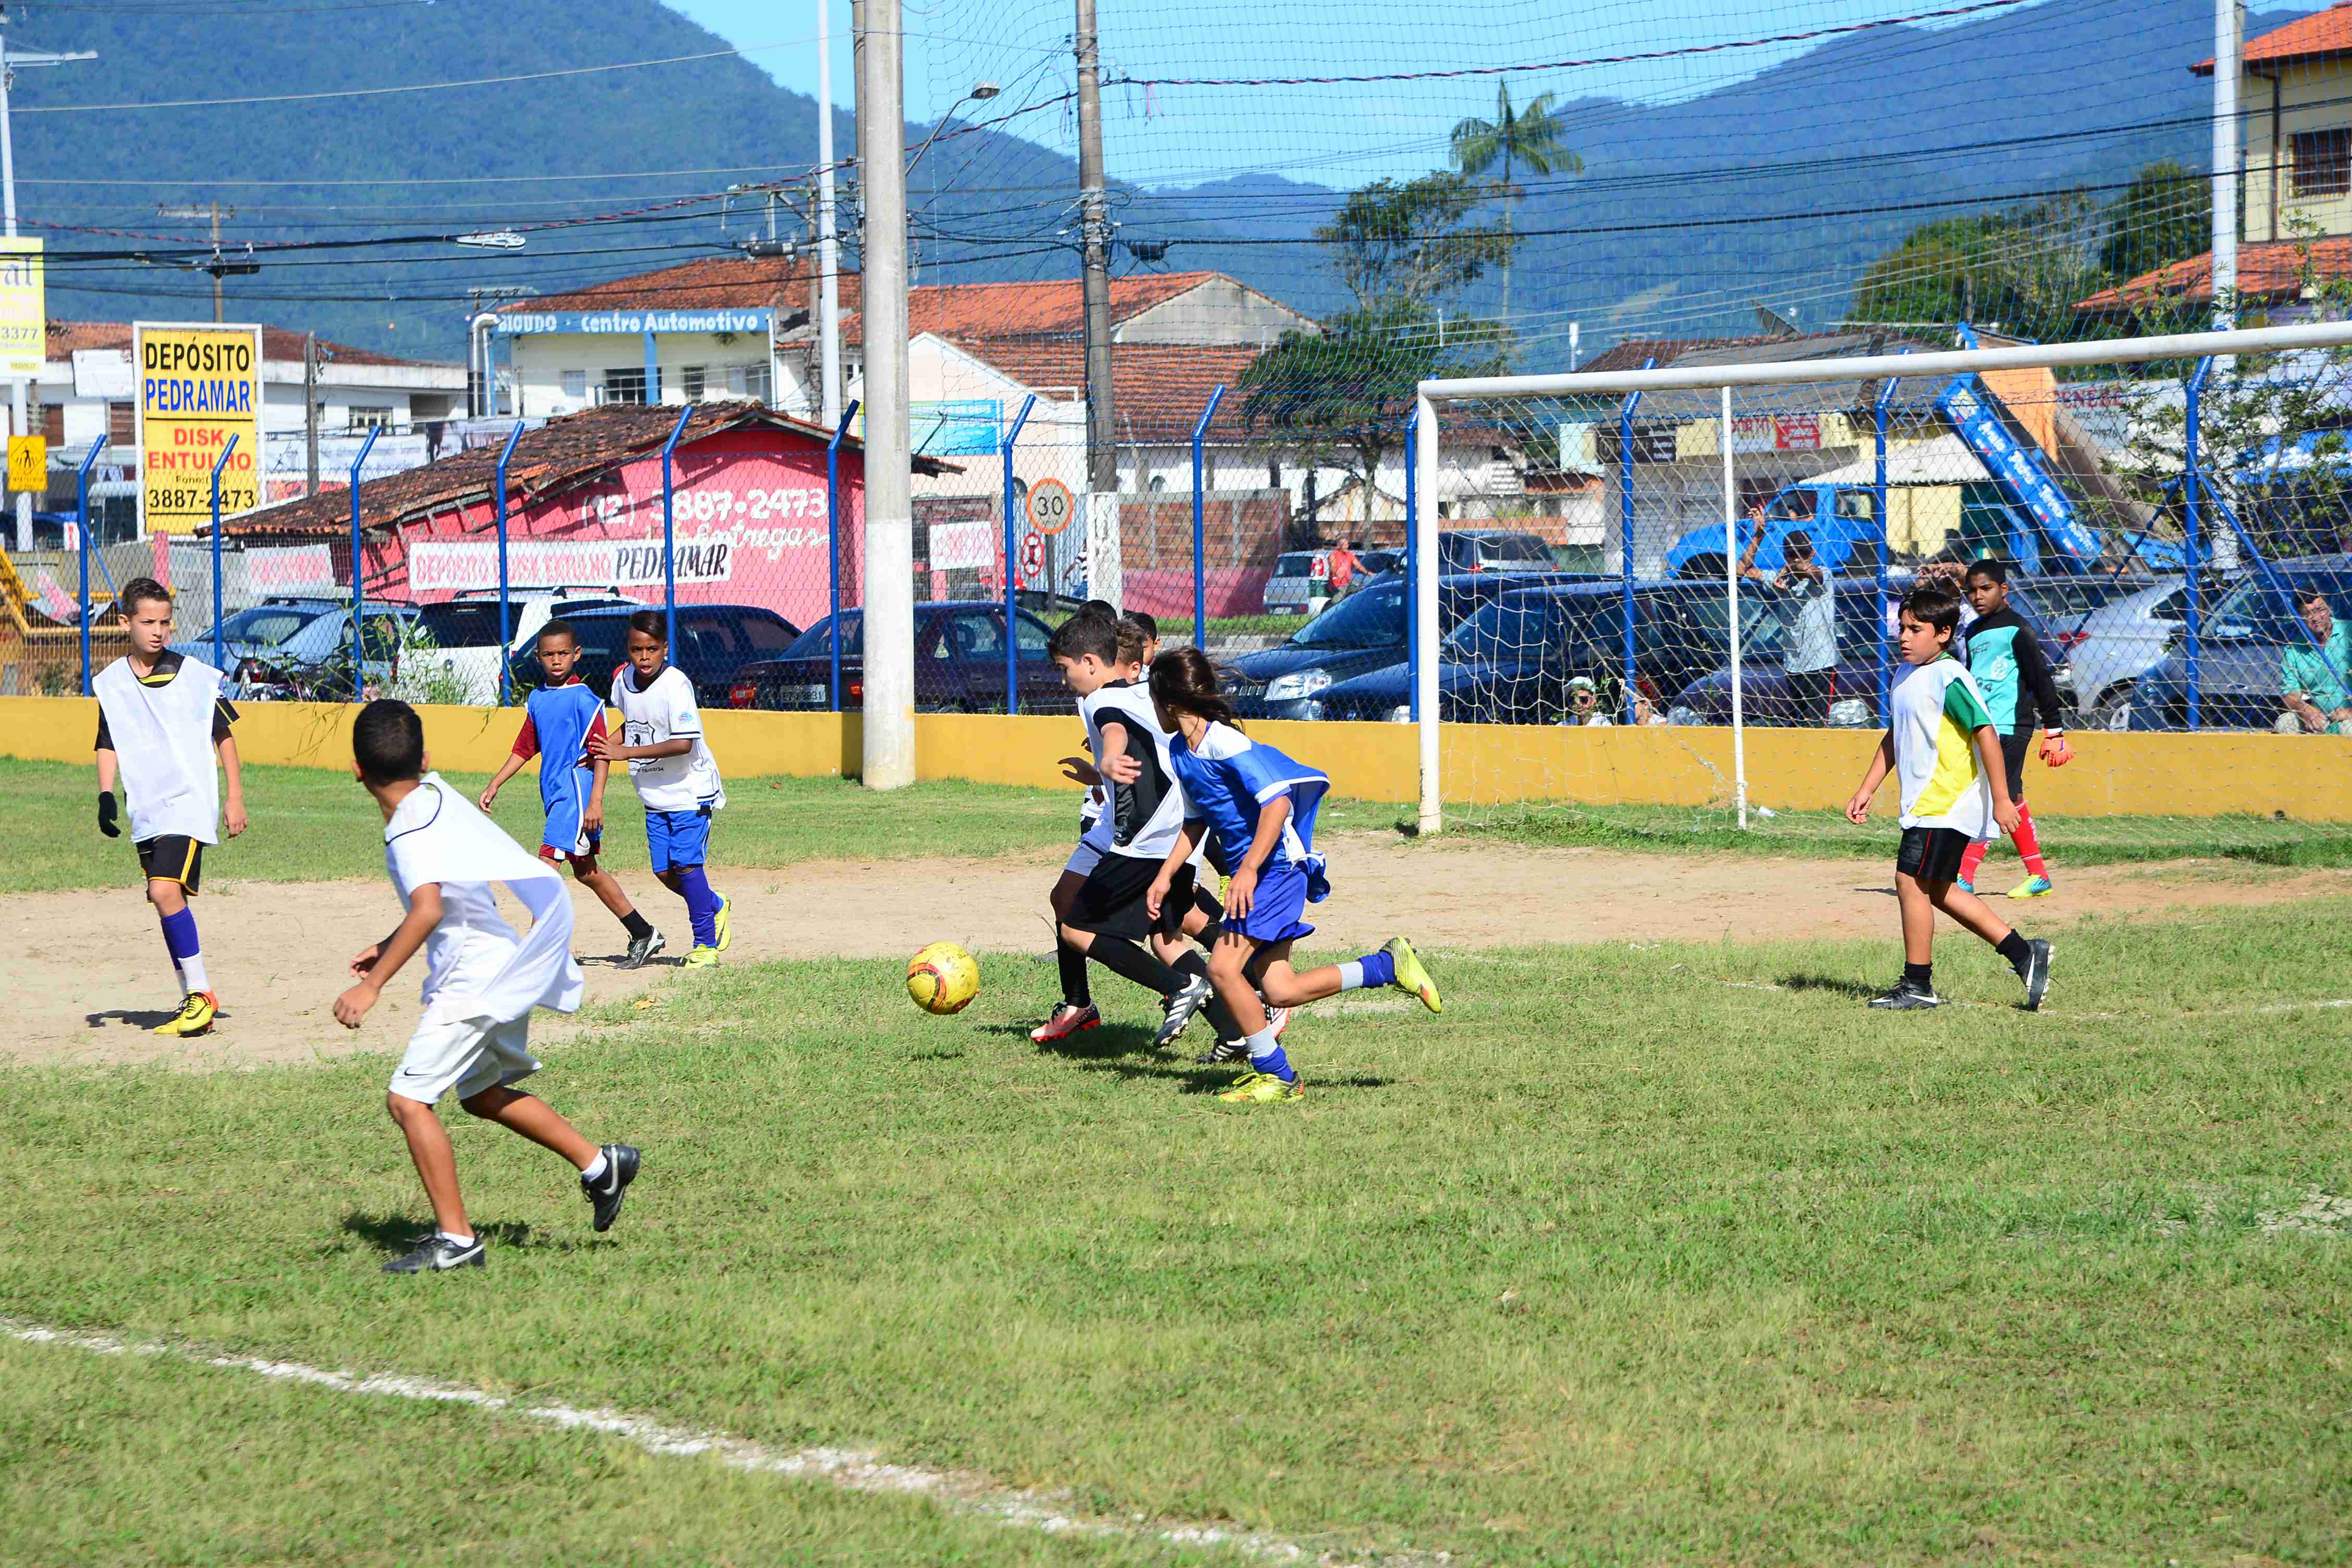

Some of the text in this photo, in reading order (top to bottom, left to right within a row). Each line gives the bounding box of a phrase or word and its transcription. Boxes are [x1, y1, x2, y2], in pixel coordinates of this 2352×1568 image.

[581, 312, 641, 333] Centro
[643, 313, 758, 332] Automotivo
[145, 336, 250, 371] DEPÓSITO
[145, 379, 251, 412] PEDRAMAR
[174, 428, 225, 446] DISK
[149, 489, 254, 508] 3887-2473
[1037, 496, 1063, 516] 30
[616, 544, 728, 580] PEDRAMAR
